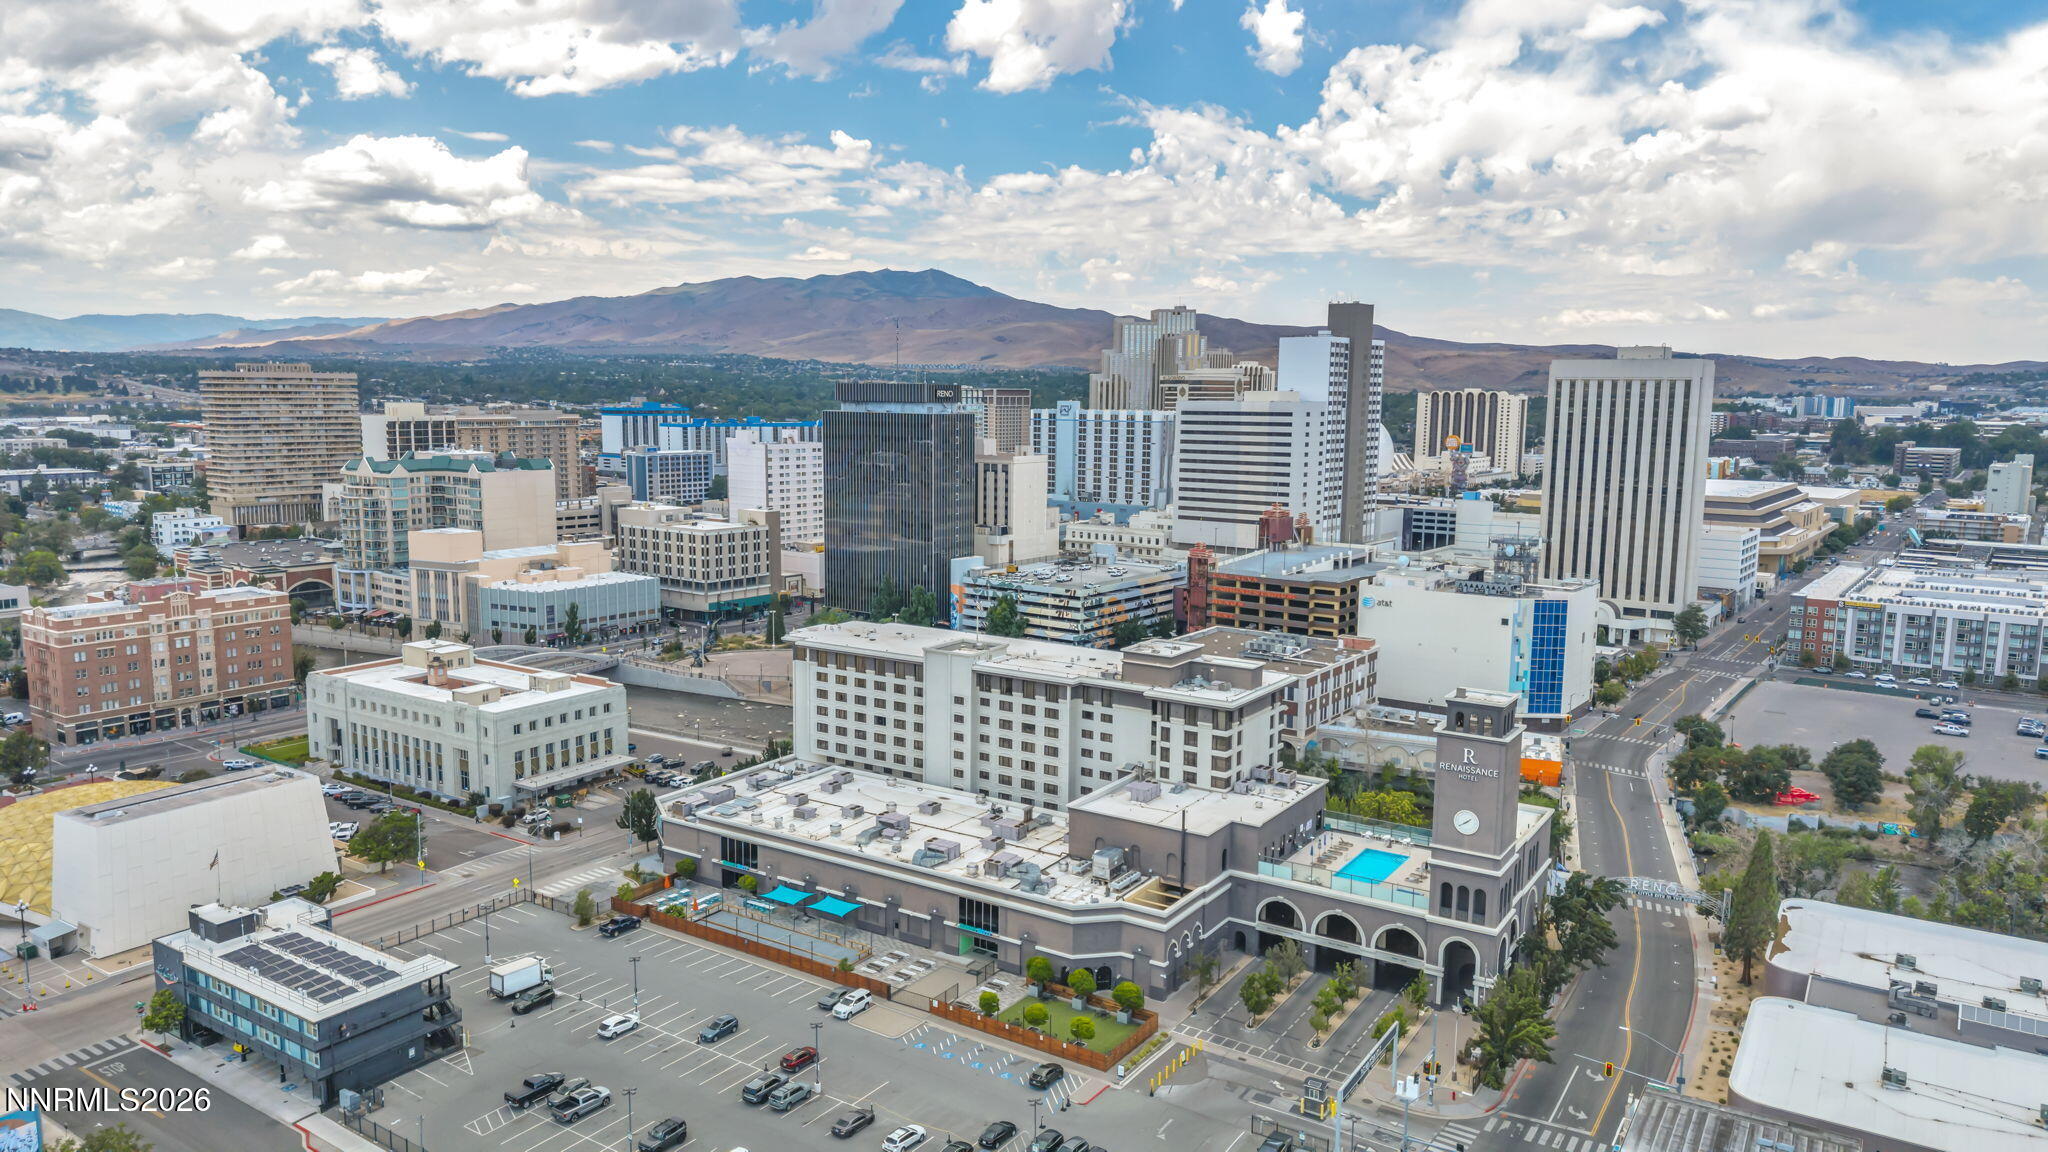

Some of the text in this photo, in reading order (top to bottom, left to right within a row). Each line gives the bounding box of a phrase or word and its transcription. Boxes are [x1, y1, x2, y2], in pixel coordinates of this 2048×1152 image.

[936, 390, 954, 398] RENO
[1463, 748, 1479, 765] R
[1440, 761, 1500, 778] RENAISSANCE
[1458, 774, 1479, 782] HOTEL
[1630, 879, 1677, 896] RENO
[98, 1062, 128, 1077] STOP
